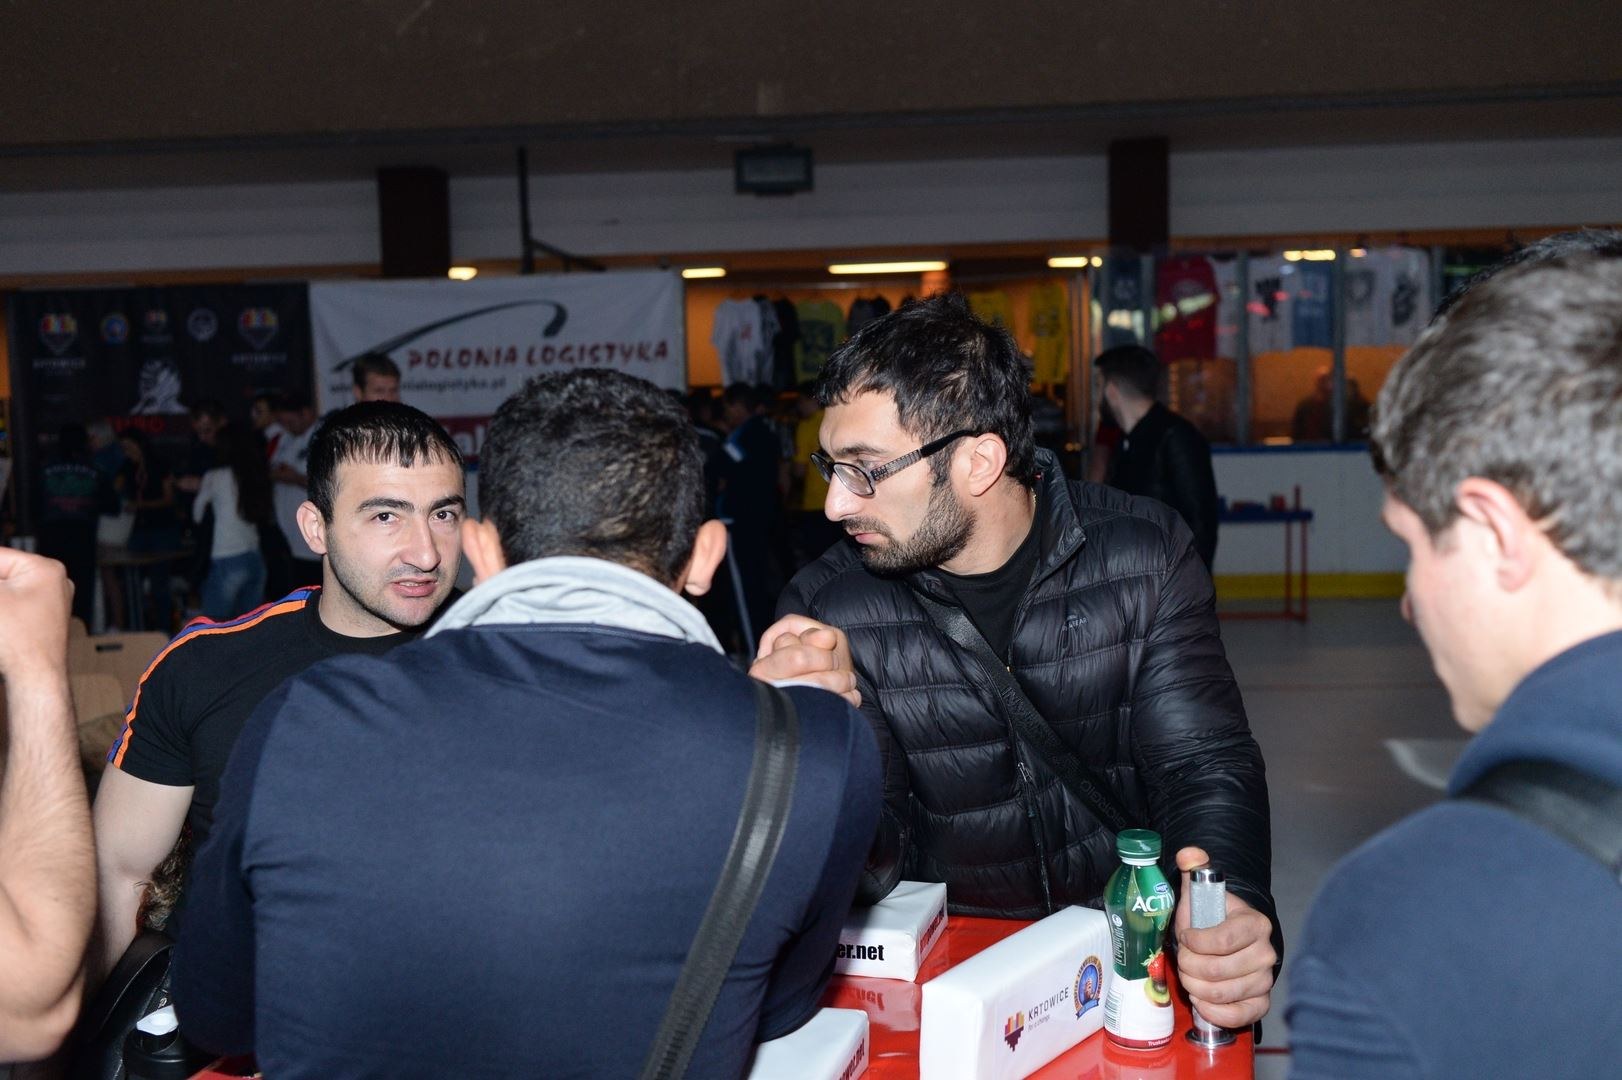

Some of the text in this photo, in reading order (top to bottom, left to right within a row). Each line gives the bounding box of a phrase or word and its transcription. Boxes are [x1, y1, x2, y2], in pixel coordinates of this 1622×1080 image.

[407, 340, 668, 369] POLONIA LOGISTYKA
[1028, 987, 1069, 1021] KATOWICE
